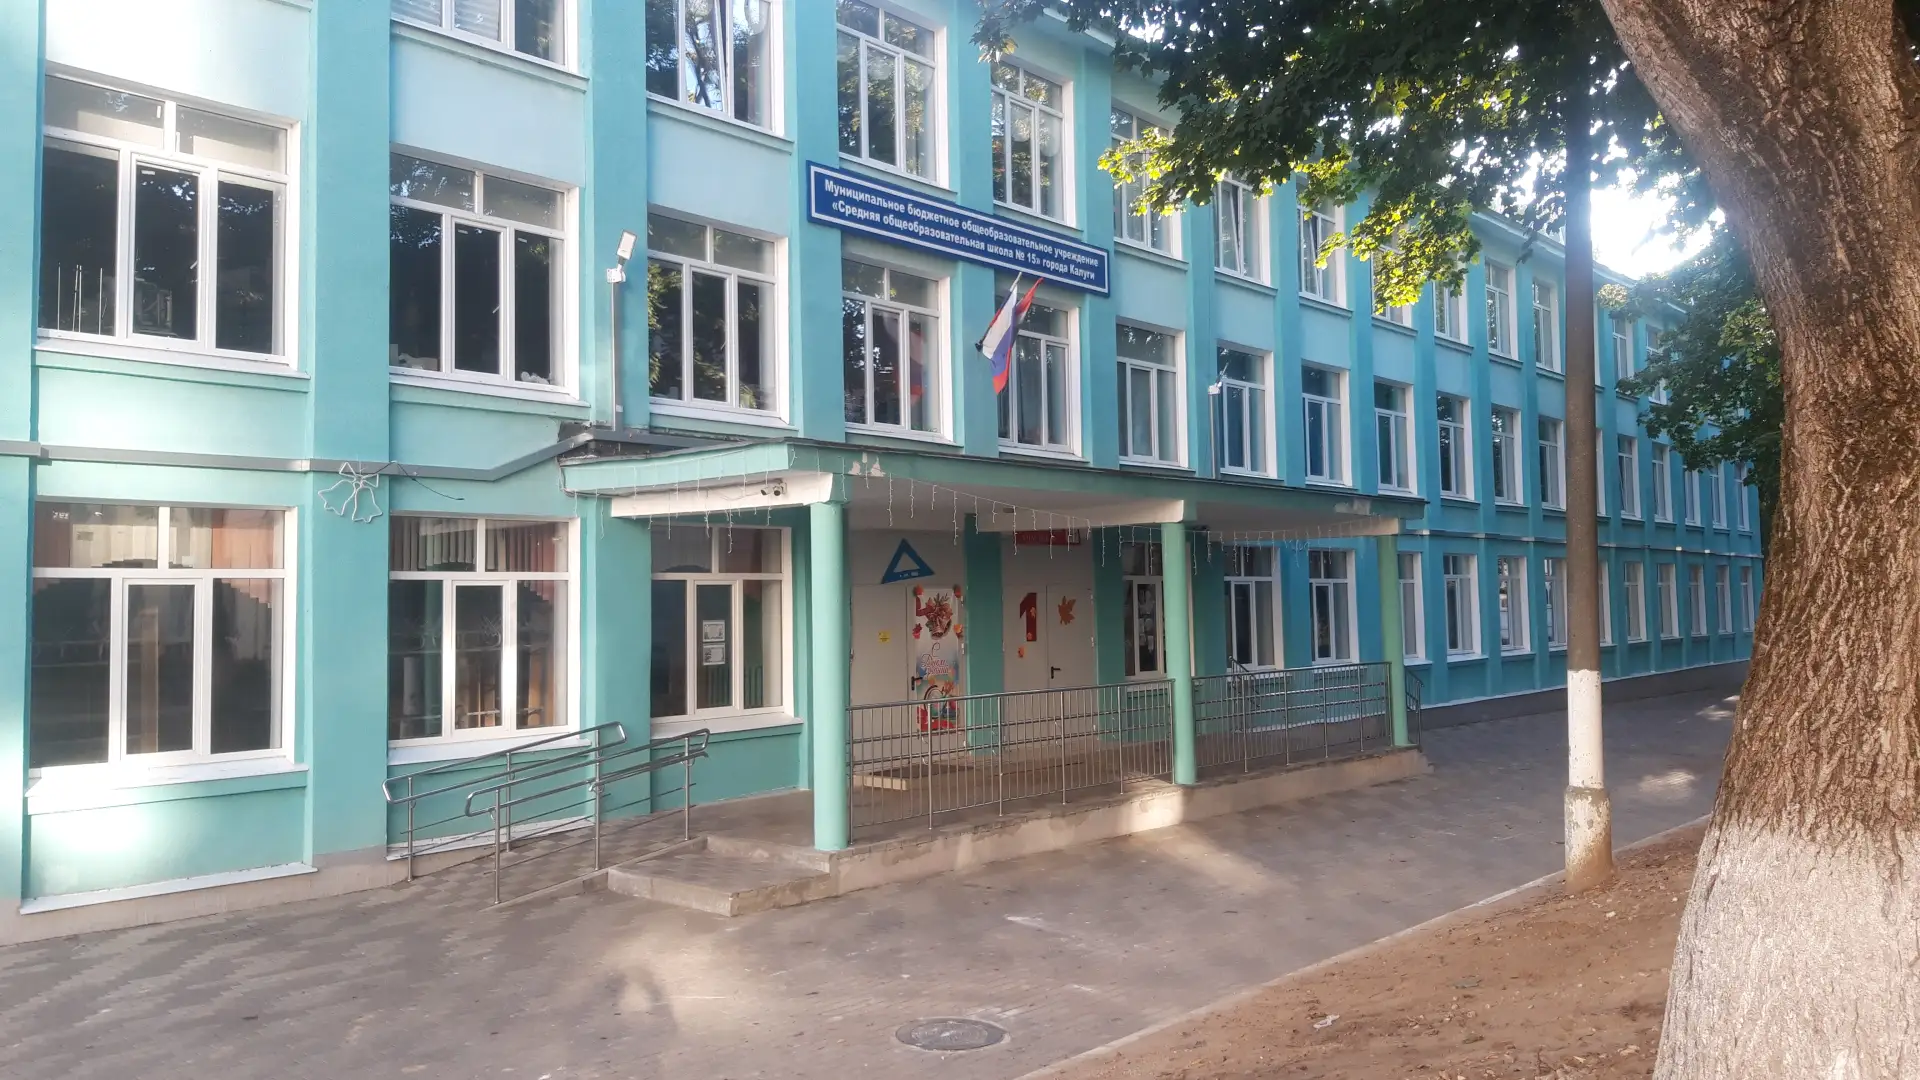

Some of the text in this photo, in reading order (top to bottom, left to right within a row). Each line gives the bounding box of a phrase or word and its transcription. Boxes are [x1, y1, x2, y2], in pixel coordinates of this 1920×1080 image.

[825, 179, 1099, 267] Муниципальное бюджетное общеобразовательное учреждение
[832, 200, 1095, 280] «Средняя общеобразовательная школа № 15» города Калуги
[1019, 592, 1037, 642] 1
